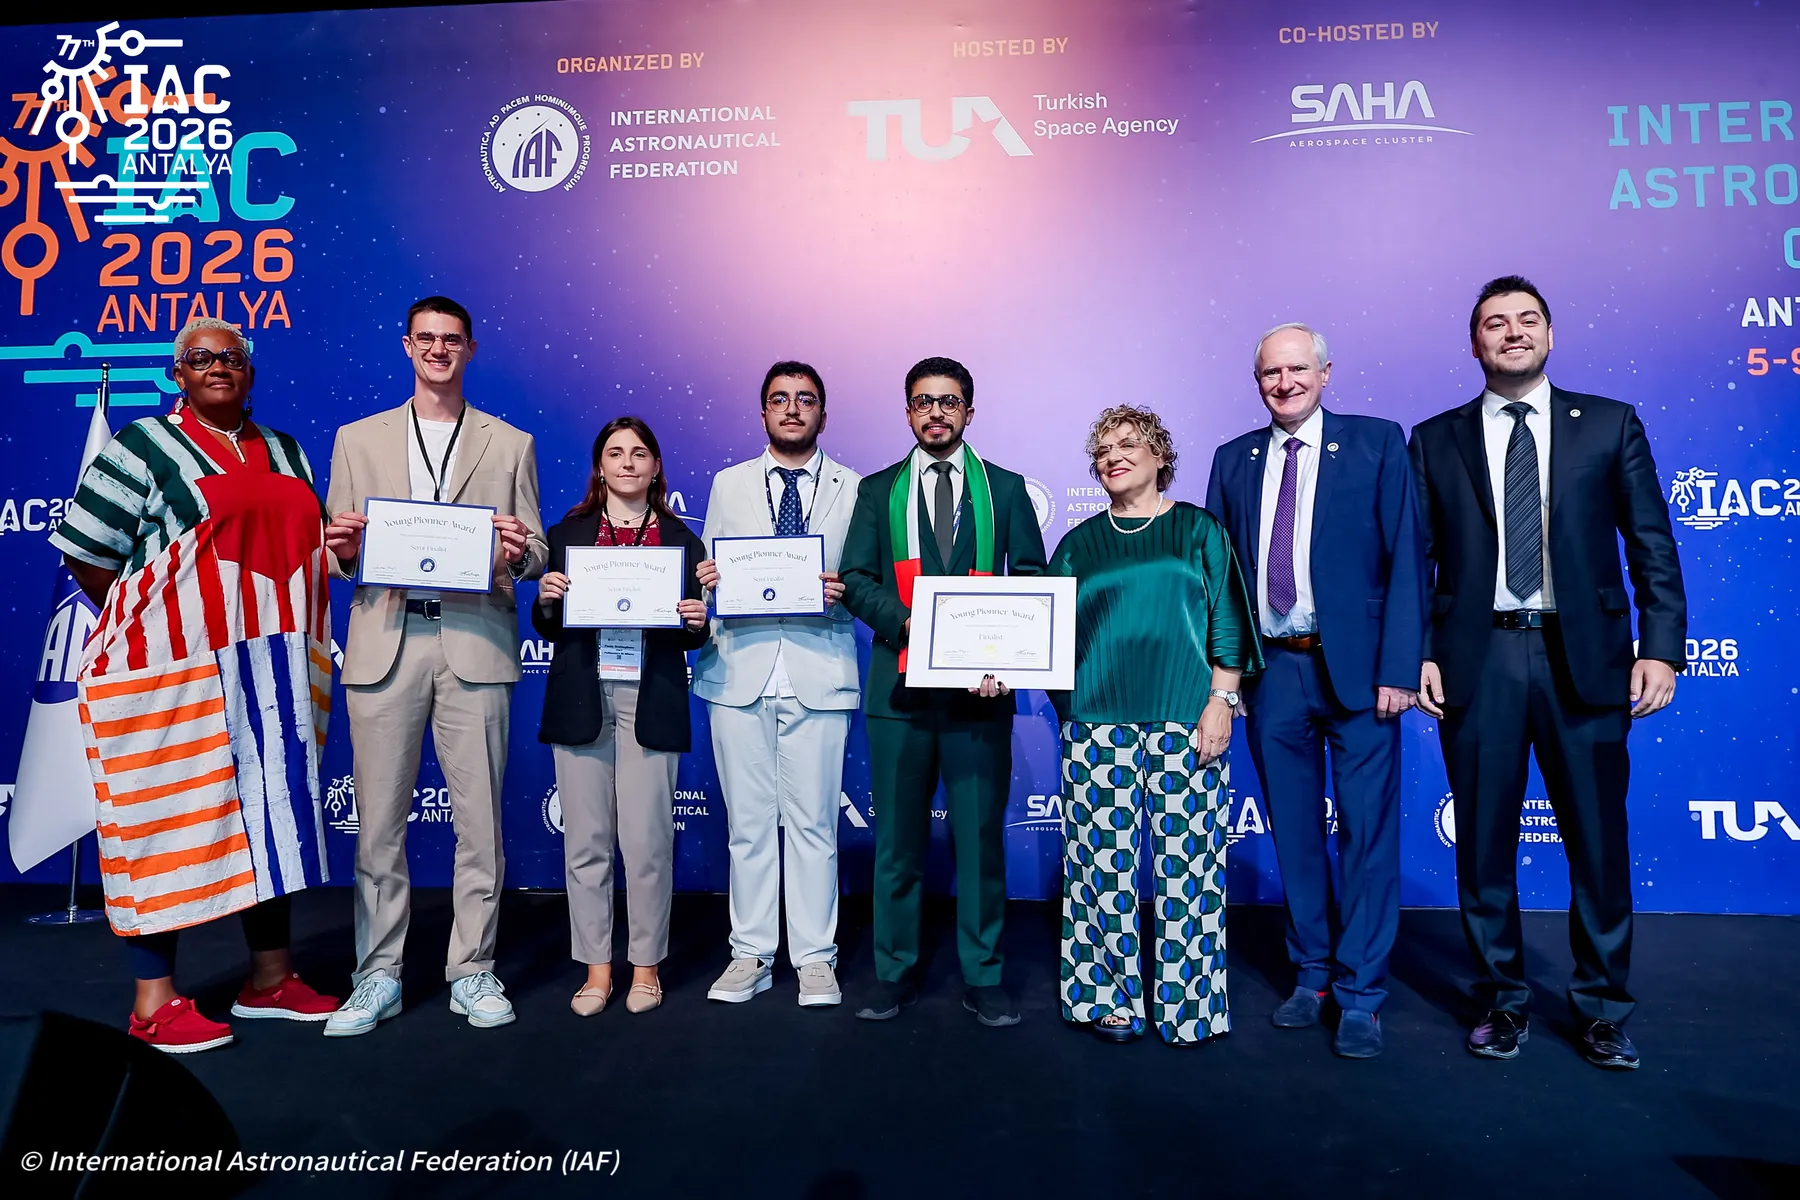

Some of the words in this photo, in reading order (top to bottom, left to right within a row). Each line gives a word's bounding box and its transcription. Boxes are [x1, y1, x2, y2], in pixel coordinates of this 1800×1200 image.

[1278, 22, 1405, 44] CO-HOSTED
[1411, 21, 1439, 39] BY
[953, 38, 1036, 58] HOSTED
[1042, 37, 1069, 55] BY
[556, 53, 673, 74] ORGANIZED
[679, 51, 705, 69] BY
[500, 95, 530, 115] PACEM
[534, 94, 588, 132] HOMINUMQUE
[1032, 92, 1108, 111] Turkish
[1291, 80, 1436, 123] SAHA
[488, 114, 500, 128] AD
[609, 105, 777, 126] INTERNATIONAL
[1606, 99, 1795, 147] INTER
[847, 96, 1034, 162] TUA
[1032, 118, 1098, 140] Space
[1101, 116, 1180, 138] Agency
[609, 133, 781, 153] ASTRONAUTICAL
[1289, 137, 1368, 148] AEROSPACE
[1374, 135, 1434, 145] CLUSTER
[480, 131, 507, 193] ASTRONAUTICA
[563, 134, 591, 192] PROGRESSUM
[609, 160, 739, 179] FEDERATION
[1609, 163, 1800, 210] ASTRO
[99, 228, 294, 287] 2026
[97, 290, 292, 333] ANTALYA
[1695, 478, 1782, 517] IAC
[383, 516, 413, 529] Young
[450, 520, 477, 534] Award
[583, 561, 609, 573] Young
[642, 561, 667, 574] Award
[729, 550, 753, 564] Young
[784, 551, 808, 562] Award
[949, 609, 976, 621] Young
[1010, 608, 1036, 622] Award
[1685, 638, 1739, 661] 026
[1676, 661, 1740, 677] TALYA
[1027, 794, 1062, 817] SA
[1522, 799, 1553, 811] NTER
